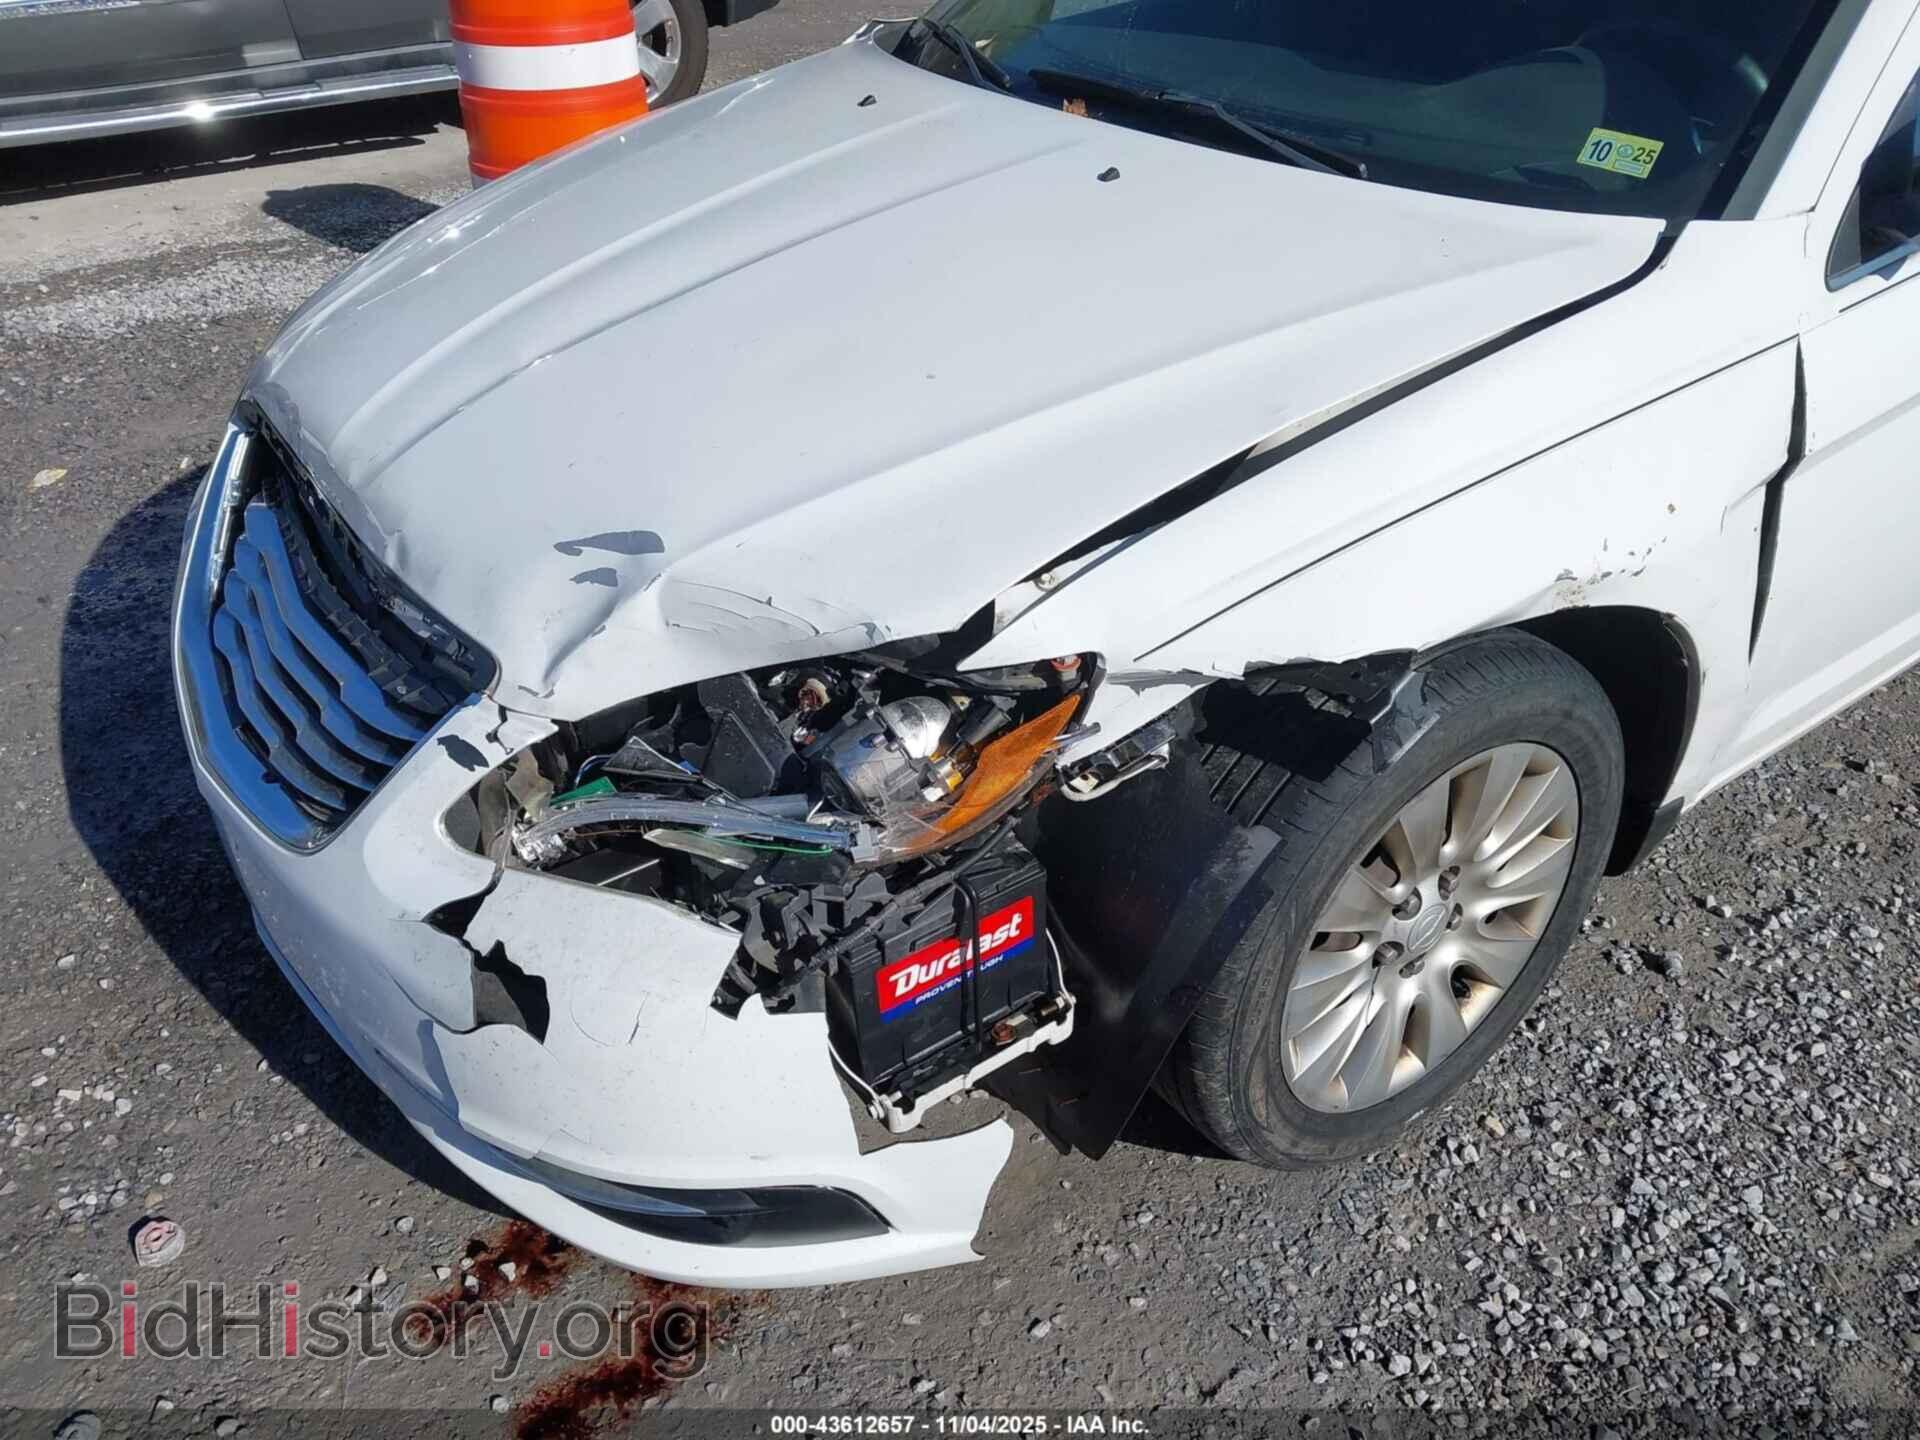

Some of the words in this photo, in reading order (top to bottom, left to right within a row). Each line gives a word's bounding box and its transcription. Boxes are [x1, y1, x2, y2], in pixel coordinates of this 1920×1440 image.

[1589, 139, 1613, 162] 10
[1632, 147, 1657, 165] 25
[915, 975, 962, 1005] PROVEN
[966, 954, 1004, 978] TUGH
